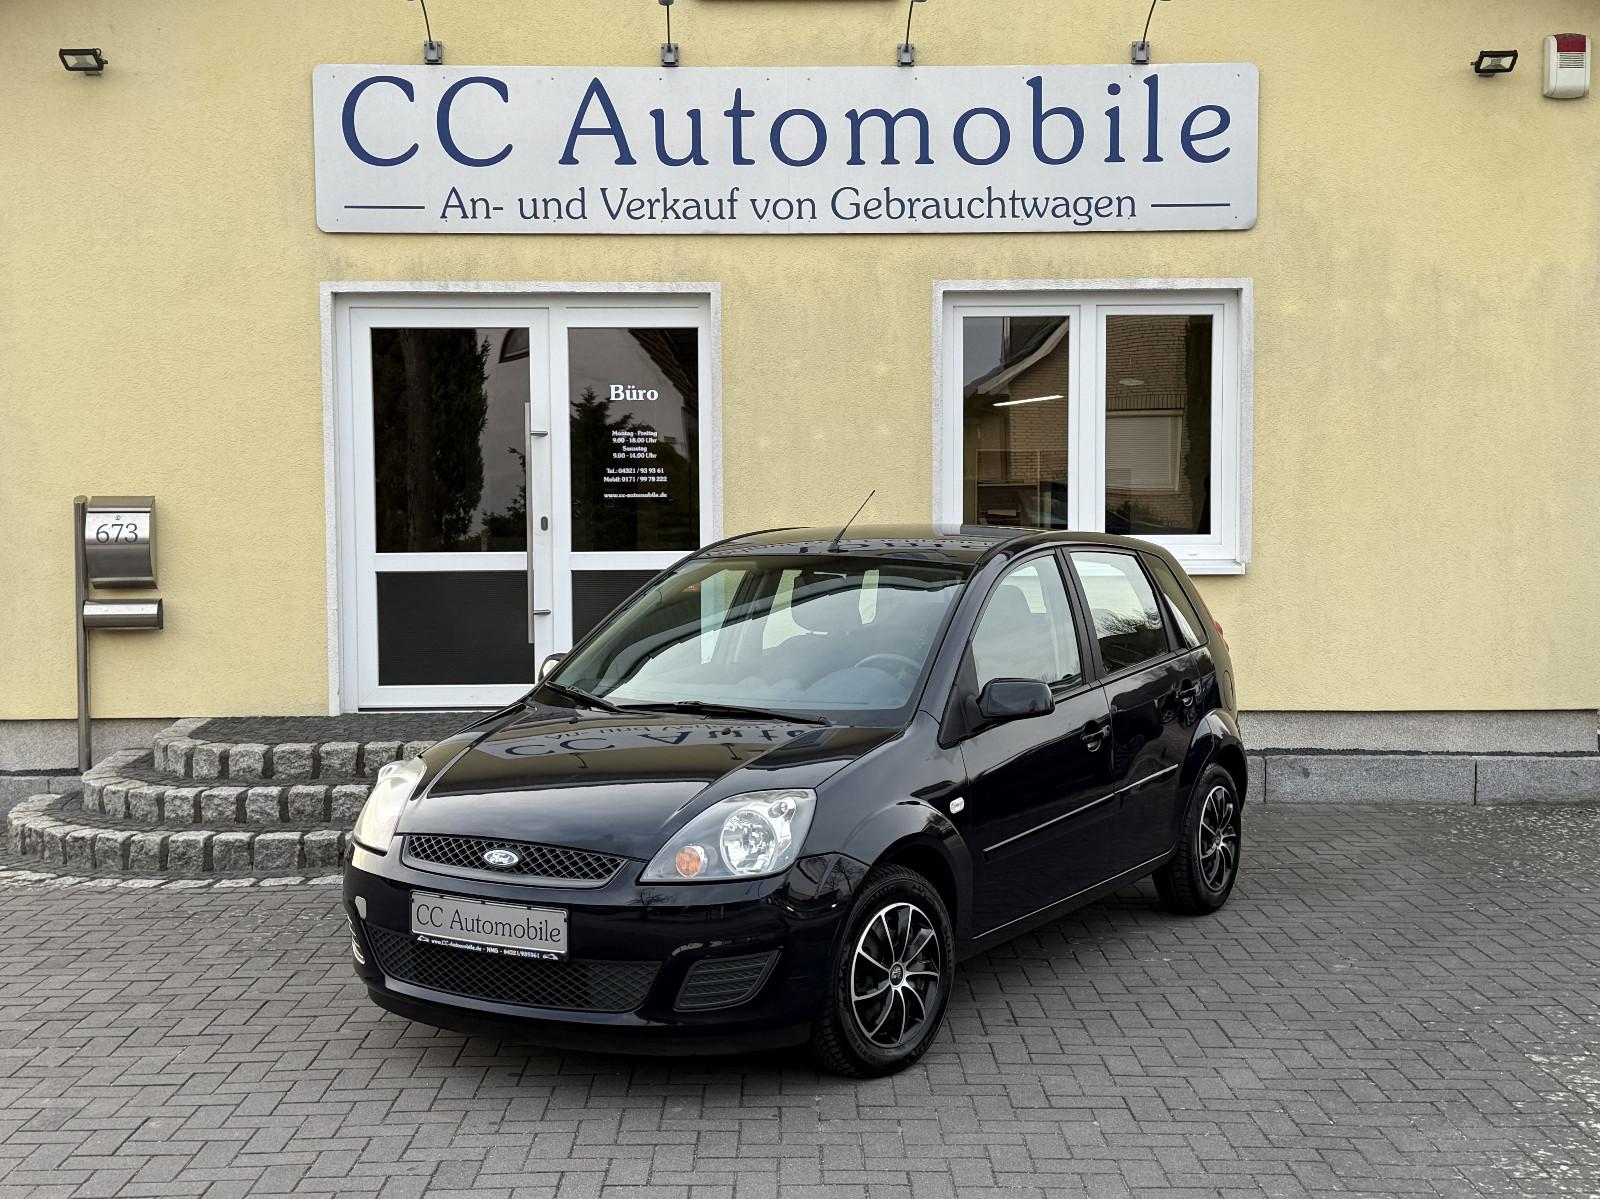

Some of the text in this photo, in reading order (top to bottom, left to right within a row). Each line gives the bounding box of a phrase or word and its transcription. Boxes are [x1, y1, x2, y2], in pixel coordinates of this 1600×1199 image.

[341, 73, 1231, 167] CC Automobile
[440, 185, 1137, 226] An- und Verkauf von Gebrauchtwagen
[609, 384, 659, 401] Büro
[96, 523, 138, 543] 673
[416, 904, 561, 943] CC Automobile
